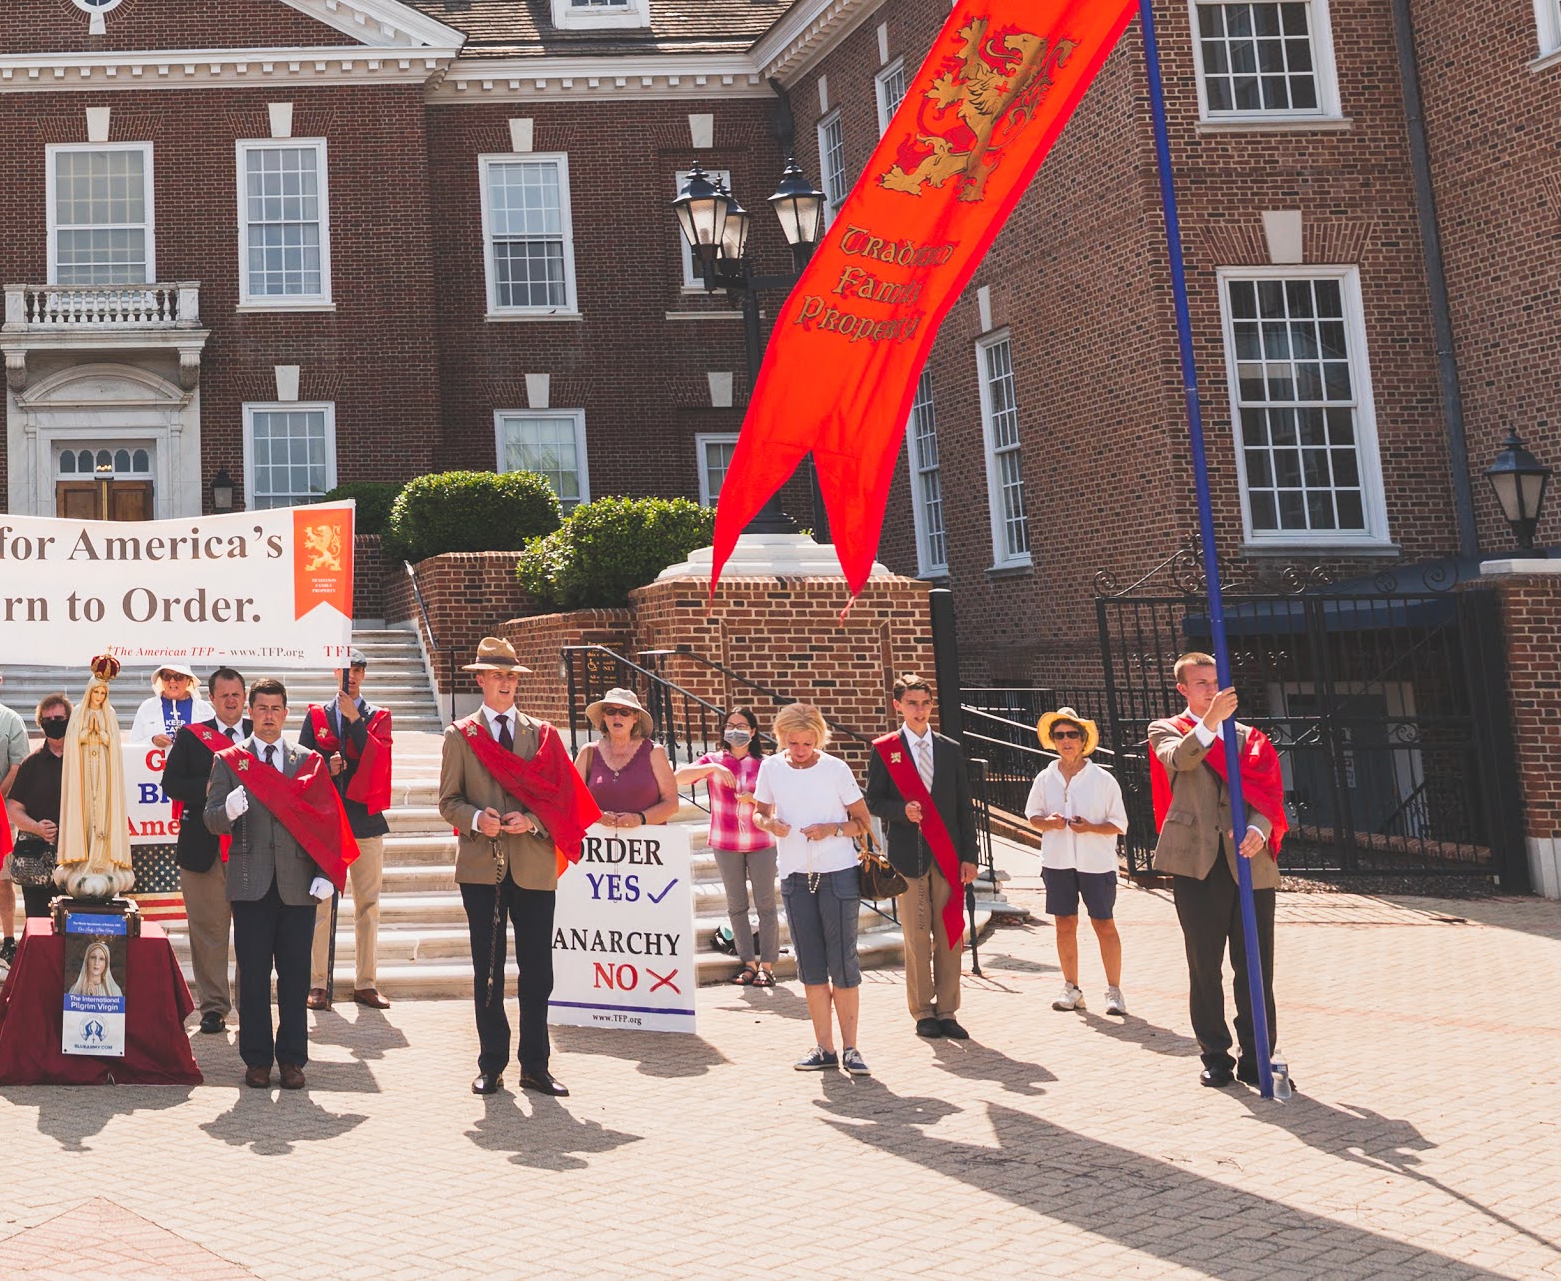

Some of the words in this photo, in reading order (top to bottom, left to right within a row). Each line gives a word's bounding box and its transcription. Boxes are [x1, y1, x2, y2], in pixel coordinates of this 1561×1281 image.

[68, 526, 283, 561] America's
[67, 589, 106, 622] to
[122, 587, 261, 623] Order.
[113, 647, 133, 656] The
[136, 647, 187, 656] American
[191, 647, 215, 656] TFP
[230, 647, 304, 658] www.TFP.org
[586, 873, 641, 902] YES
[552, 928, 680, 956] ANARCHY
[593, 962, 638, 991] NO
[71, 1002, 96, 1010] Pilgrim
[97, 1003, 119, 1011] Virgin
[593, 1014, 642, 1025] www.TFP.org
